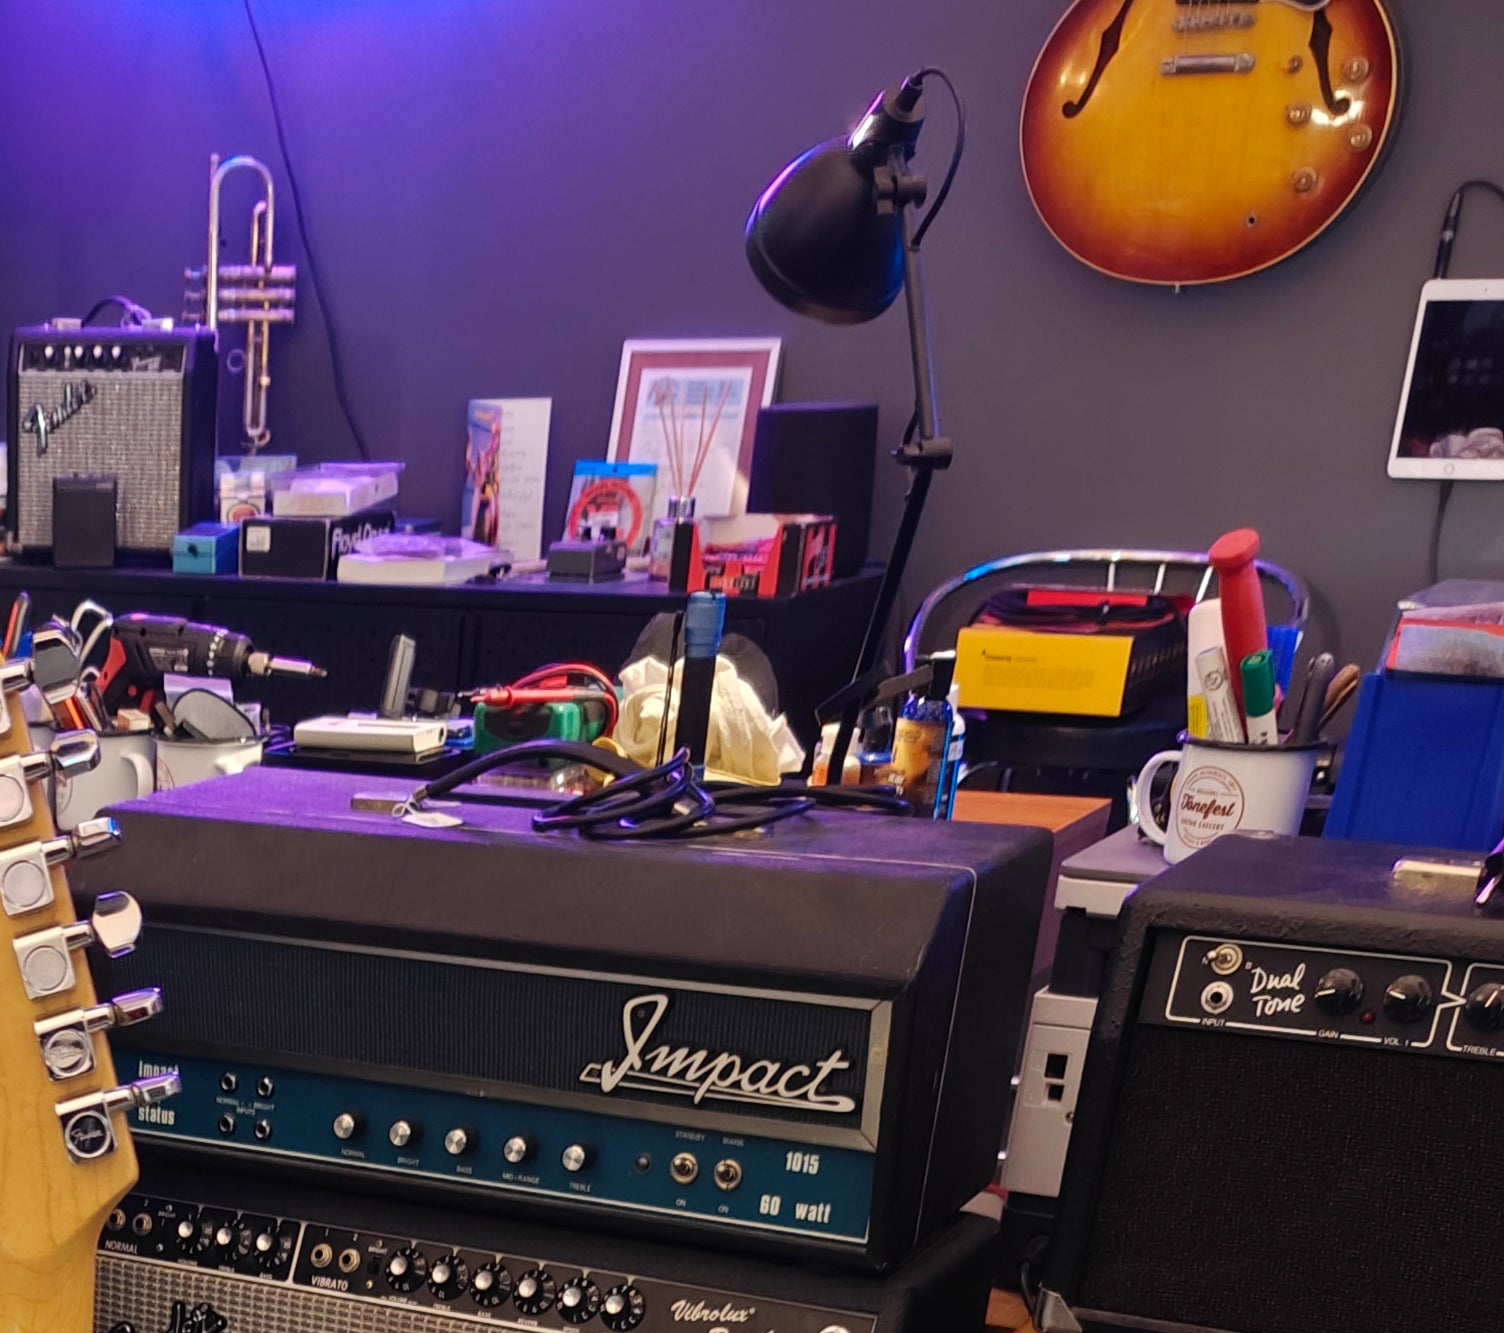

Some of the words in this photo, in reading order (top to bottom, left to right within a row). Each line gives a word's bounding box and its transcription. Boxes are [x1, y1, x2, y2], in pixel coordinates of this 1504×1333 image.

[1180, 793, 1235, 820] Tonefest
[1250, 962, 1306, 994] Dual
[1252, 993, 1306, 1017] Tone
[1201, 1018, 1227, 1028] INPUT
[1317, 1029, 1340, 1040] GAIN
[580, 994, 855, 1113] Impact
[1462, 1044, 1497, 1056] TREBLE
[138, 1106, 175, 1125] status
[785, 1151, 820, 1175] 1015
[759, 1194, 781, 1216] 60
[795, 1202, 831, 1224] watt
[104, 1240, 139, 1255] NORMAL
[311, 1275, 348, 1292] VIBRATO
[670, 1299, 749, 1322] Vibrolux
